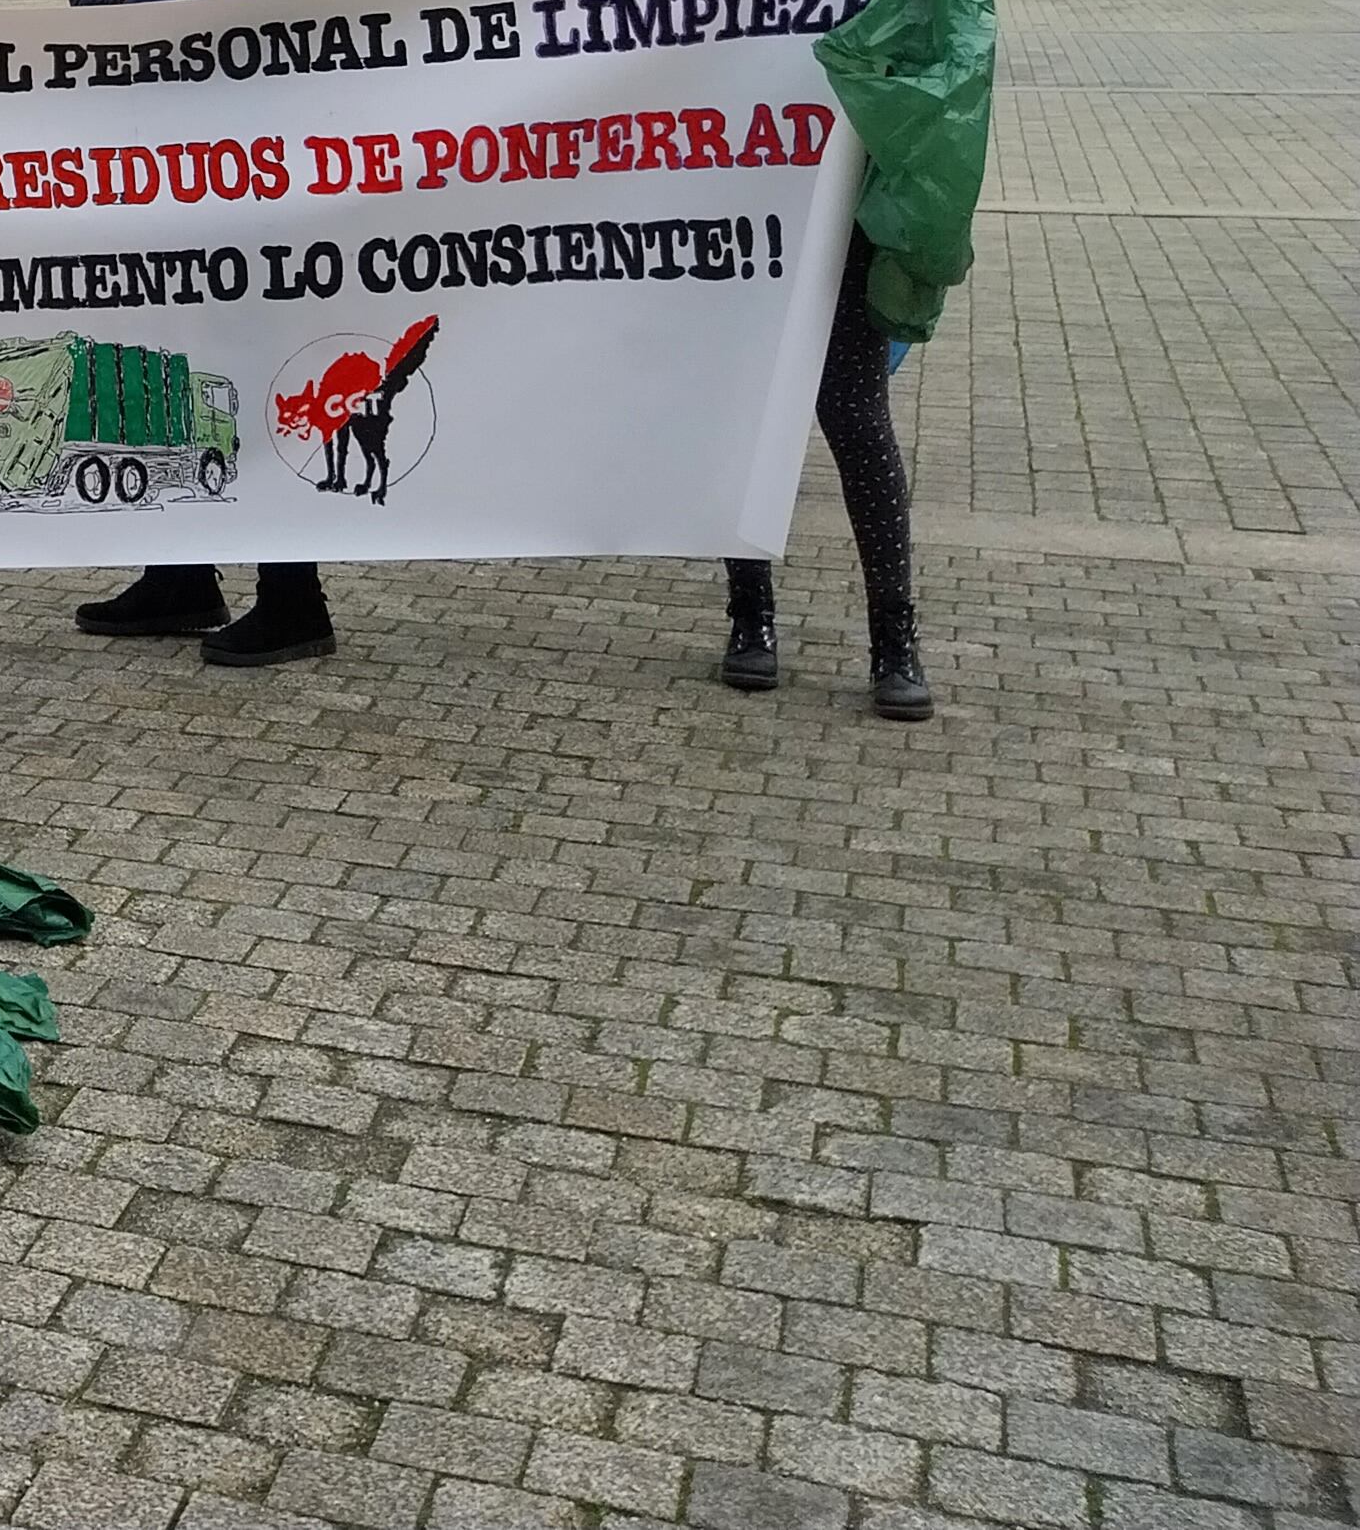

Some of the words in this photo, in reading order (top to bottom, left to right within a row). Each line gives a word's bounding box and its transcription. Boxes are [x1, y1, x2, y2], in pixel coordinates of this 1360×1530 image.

[43, 12, 408, 90] PERSONAL
[420, 1, 521, 65] DE
[303, 133, 403, 195] DE
[260, 241, 344, 301] LO
[357, 213, 783, 295] CONSIENTE!!
[324, 390, 383, 418] CGT
